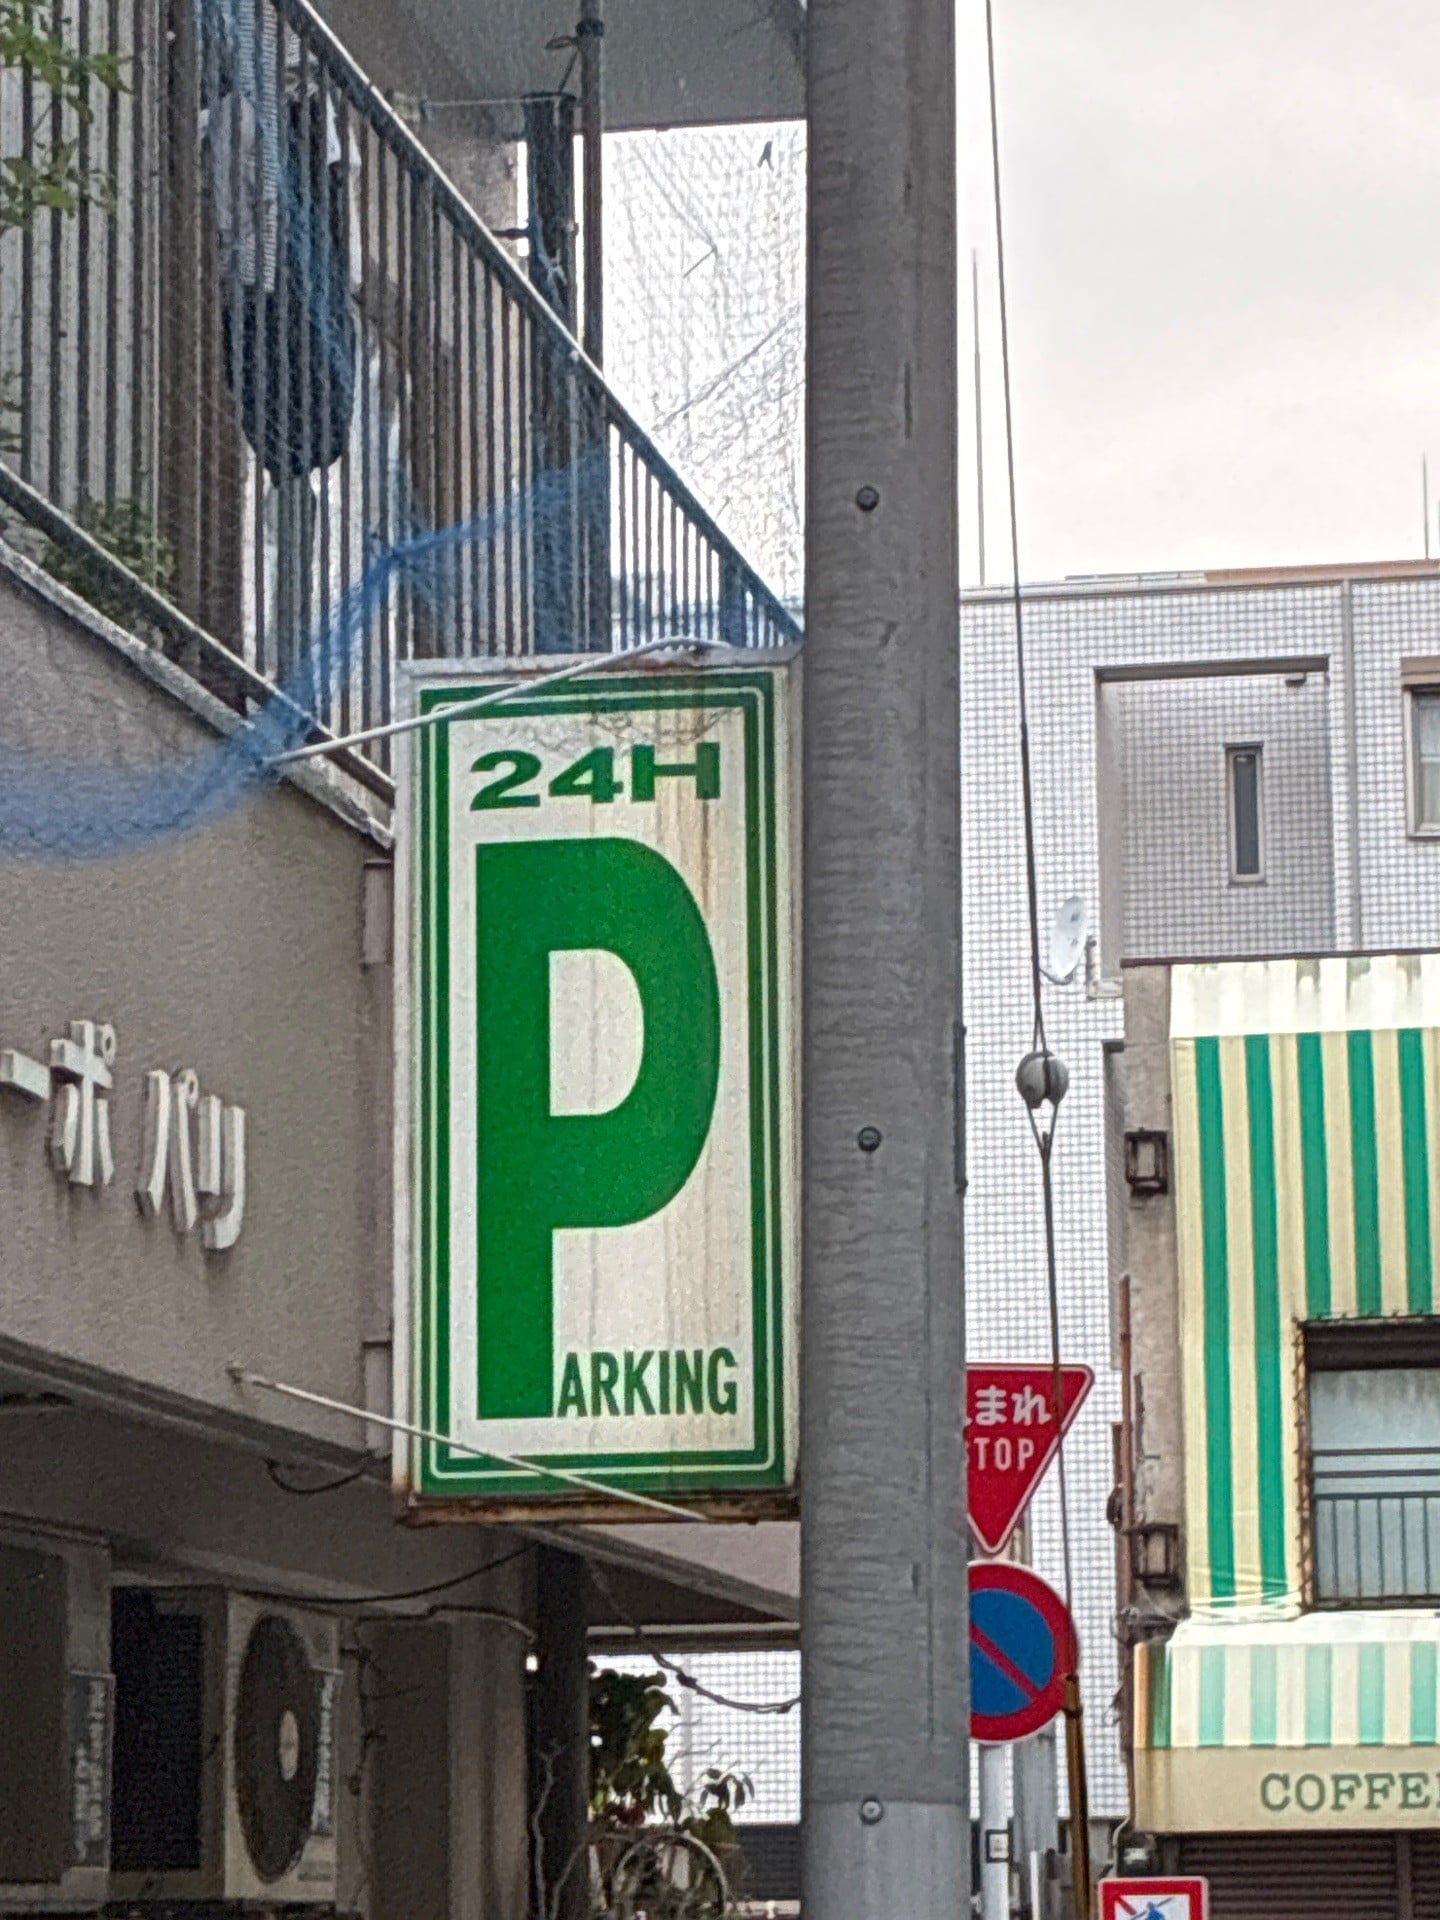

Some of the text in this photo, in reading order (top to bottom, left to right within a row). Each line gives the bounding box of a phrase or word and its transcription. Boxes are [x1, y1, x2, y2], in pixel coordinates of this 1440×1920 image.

[470, 742, 721, 811] 24H
[966, 1384, 1052, 1426] まれ
[965, 1437, 1035, 1471] TOP
[1260, 1772, 1440, 1811] COFFE
